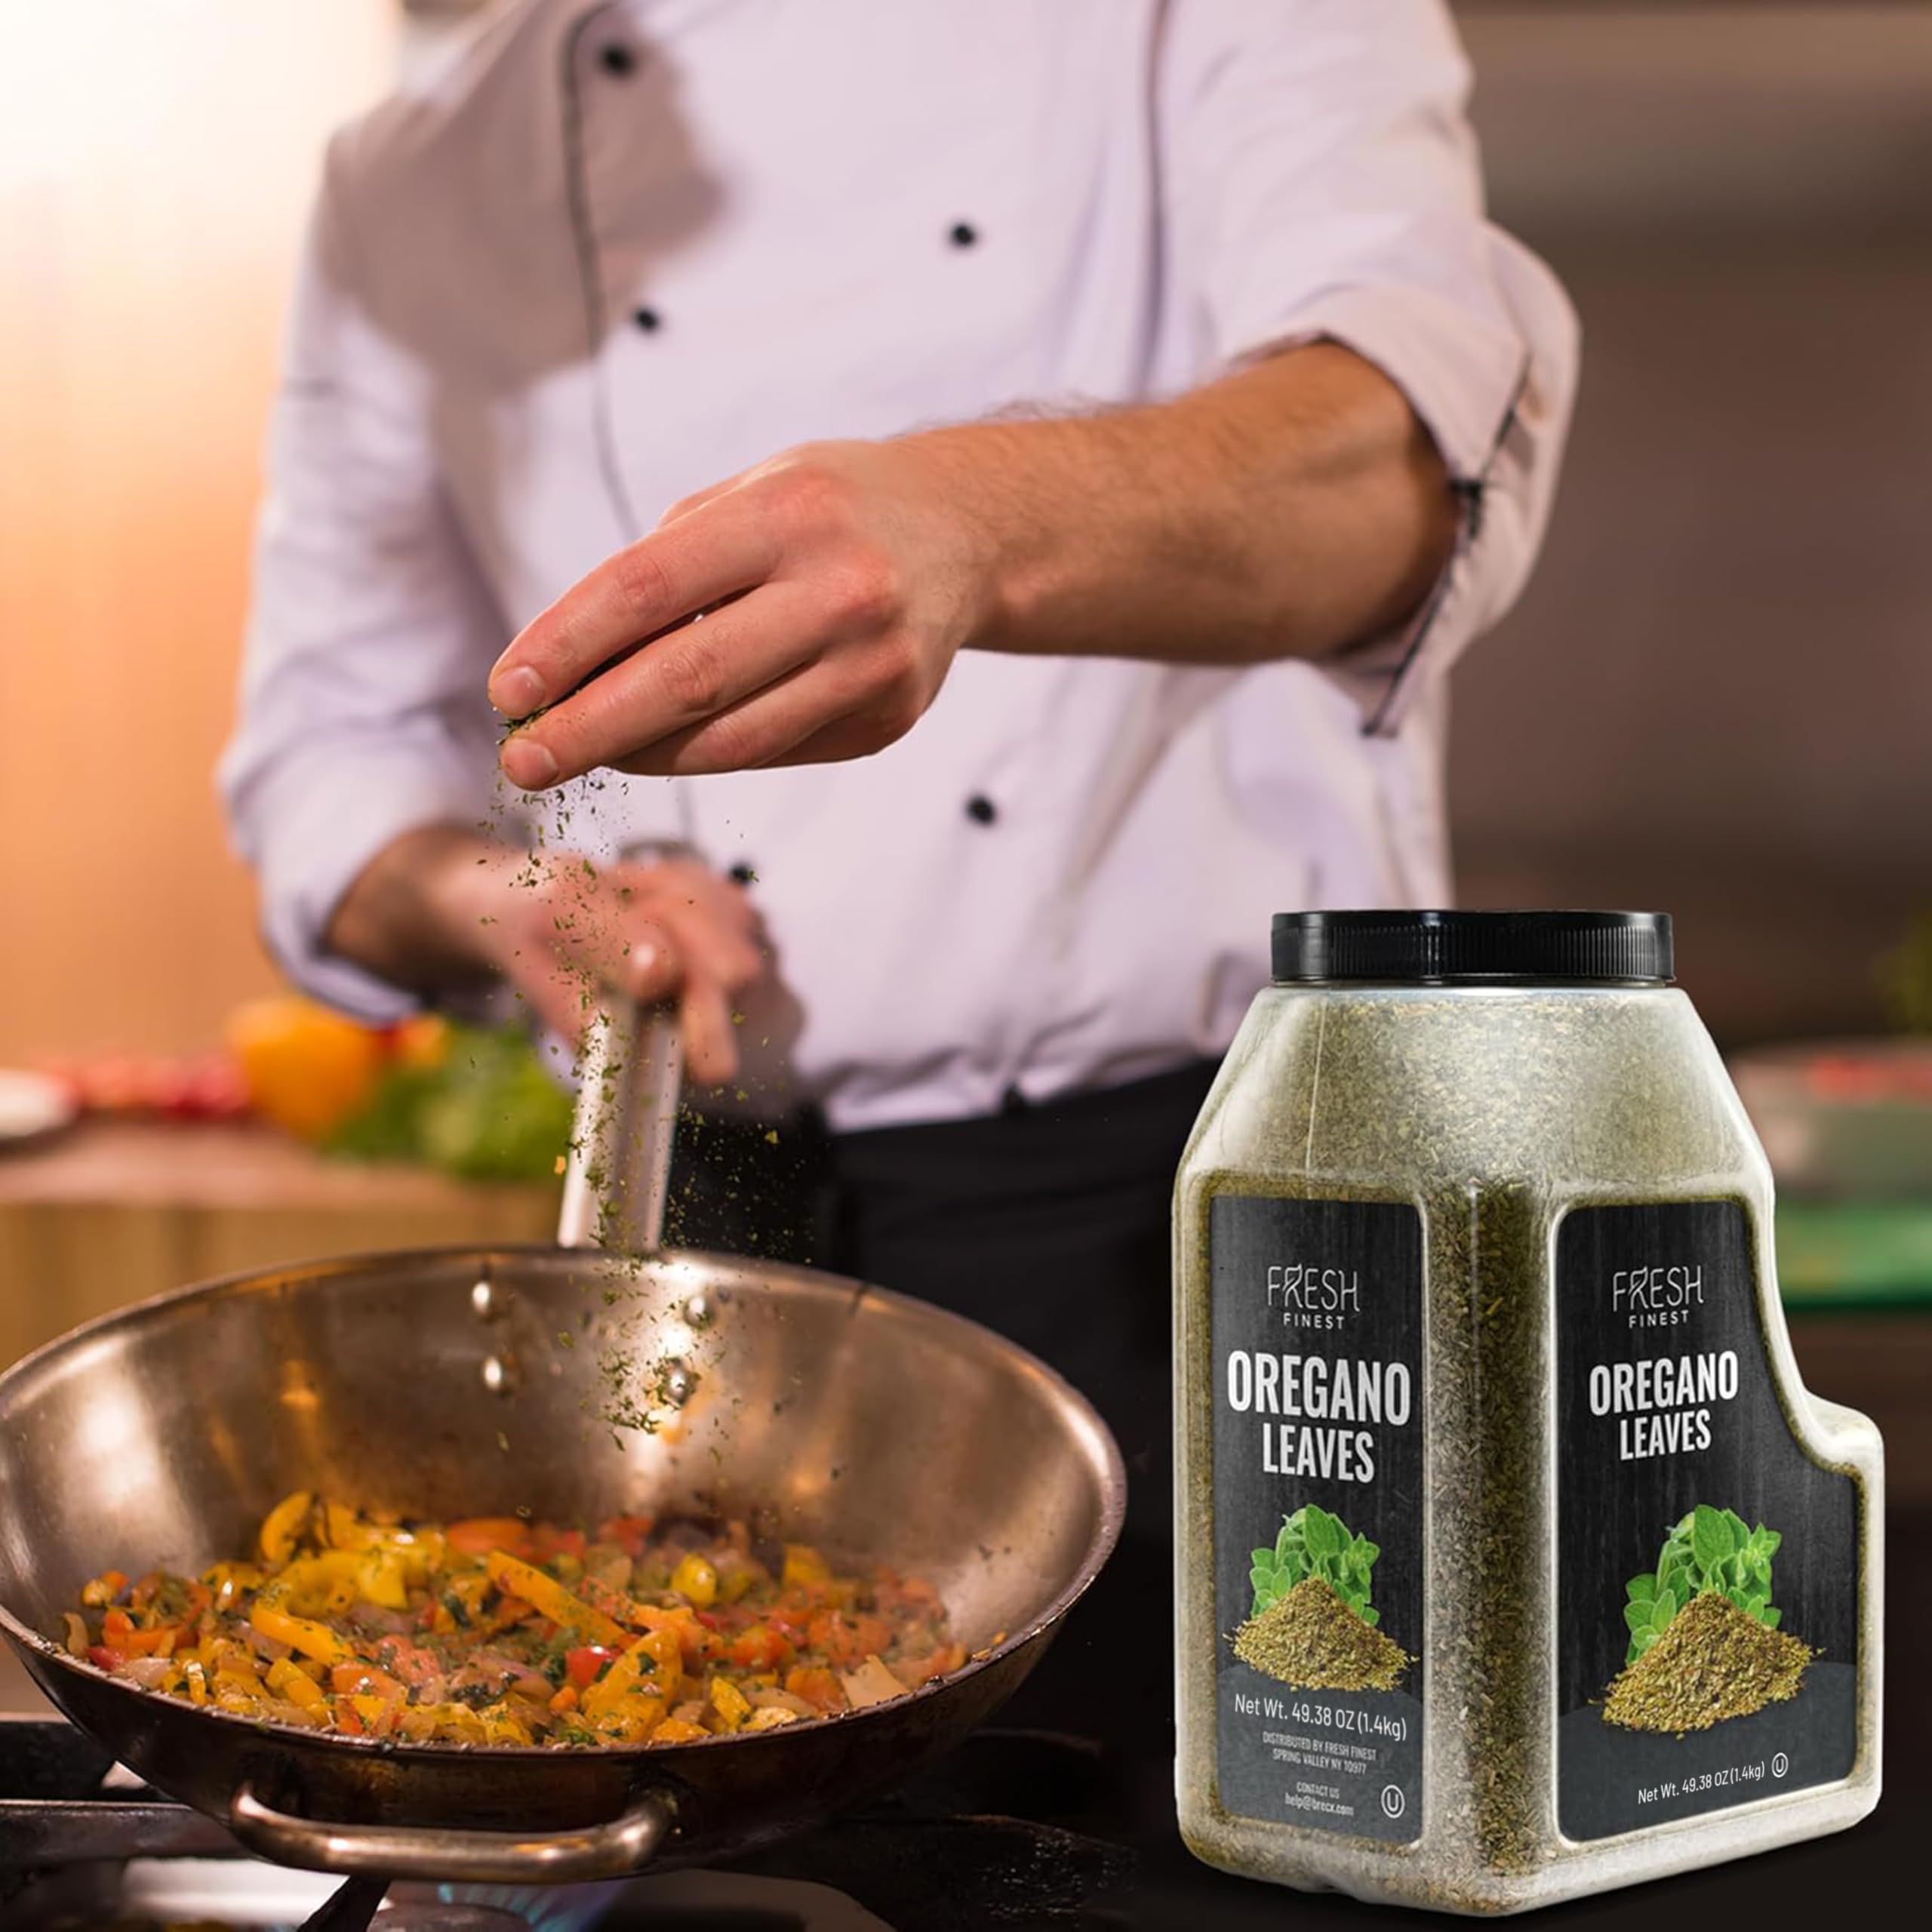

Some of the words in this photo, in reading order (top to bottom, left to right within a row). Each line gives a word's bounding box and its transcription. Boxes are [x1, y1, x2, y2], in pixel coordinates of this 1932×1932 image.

[1268, 1263, 1360, 1312] FRESH
[1613, 1265, 1704, 1312] FRESH
[1283, 1312, 1345, 1330] FINEST
[1629, 1309, 1689, 1328] FINEST
[1228, 1350, 1411, 1426] OREGANO
[1589, 1350, 1739, 1416] OREGANO
[1620, 1408, 1712, 1460] LEAVES
[1263, 1423, 1374, 1483] LEAVES
[1235, 1694, 1260, 1715] Net
[1263, 1698, 1288, 1720] Wt.
[1291, 1702, 1331, 1726] 49.38
[1263, 1731, 1311, 1750] DISTRIBUTED
[1312, 1740, 1324, 1752] BY
[1324, 1741, 1349, 1757] FRESH
[1351, 1745, 1377, 1761] FINEST
[1272, 1748, 1300, 1764] SPRING
[1303, 1754, 1330, 1770] VALLEY
[1331, 1758, 1344, 1771] NY
[1344, 1761, 1367, 1775] 10977
[1296, 1781, 1329, 1797] CONTACT
[1329, 1787, 1340, 1799] US
[1638, 1787, 1658, 1804] Net
[1660, 1783, 1679, 1799] Wt.
[1681, 1774, 1712, 1794] 49.38
